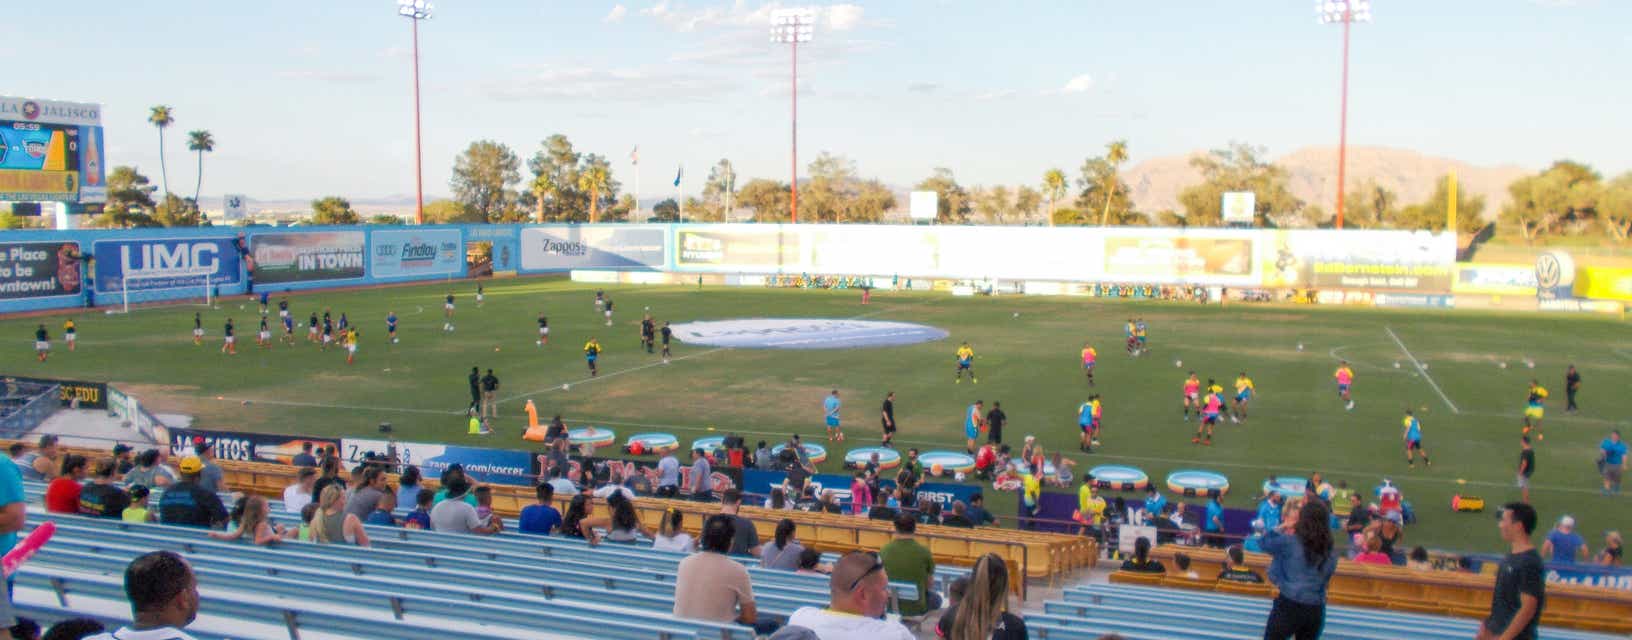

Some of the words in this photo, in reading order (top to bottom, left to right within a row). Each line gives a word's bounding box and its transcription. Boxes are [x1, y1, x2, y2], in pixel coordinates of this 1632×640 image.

[41, 104, 97, 119] JALISCO
[10, 247, 47, 261] Place
[401, 243, 437, 259] Findlay
[543, 238, 581, 255] Zappos
[120, 242, 219, 276] UMC
[298, 254, 315, 271] IN
[317, 252, 363, 270] TOWN
[15, 262, 33, 277] be
[172, 434, 250, 461] JAITOS
[916, 491, 955, 503] FIRST
